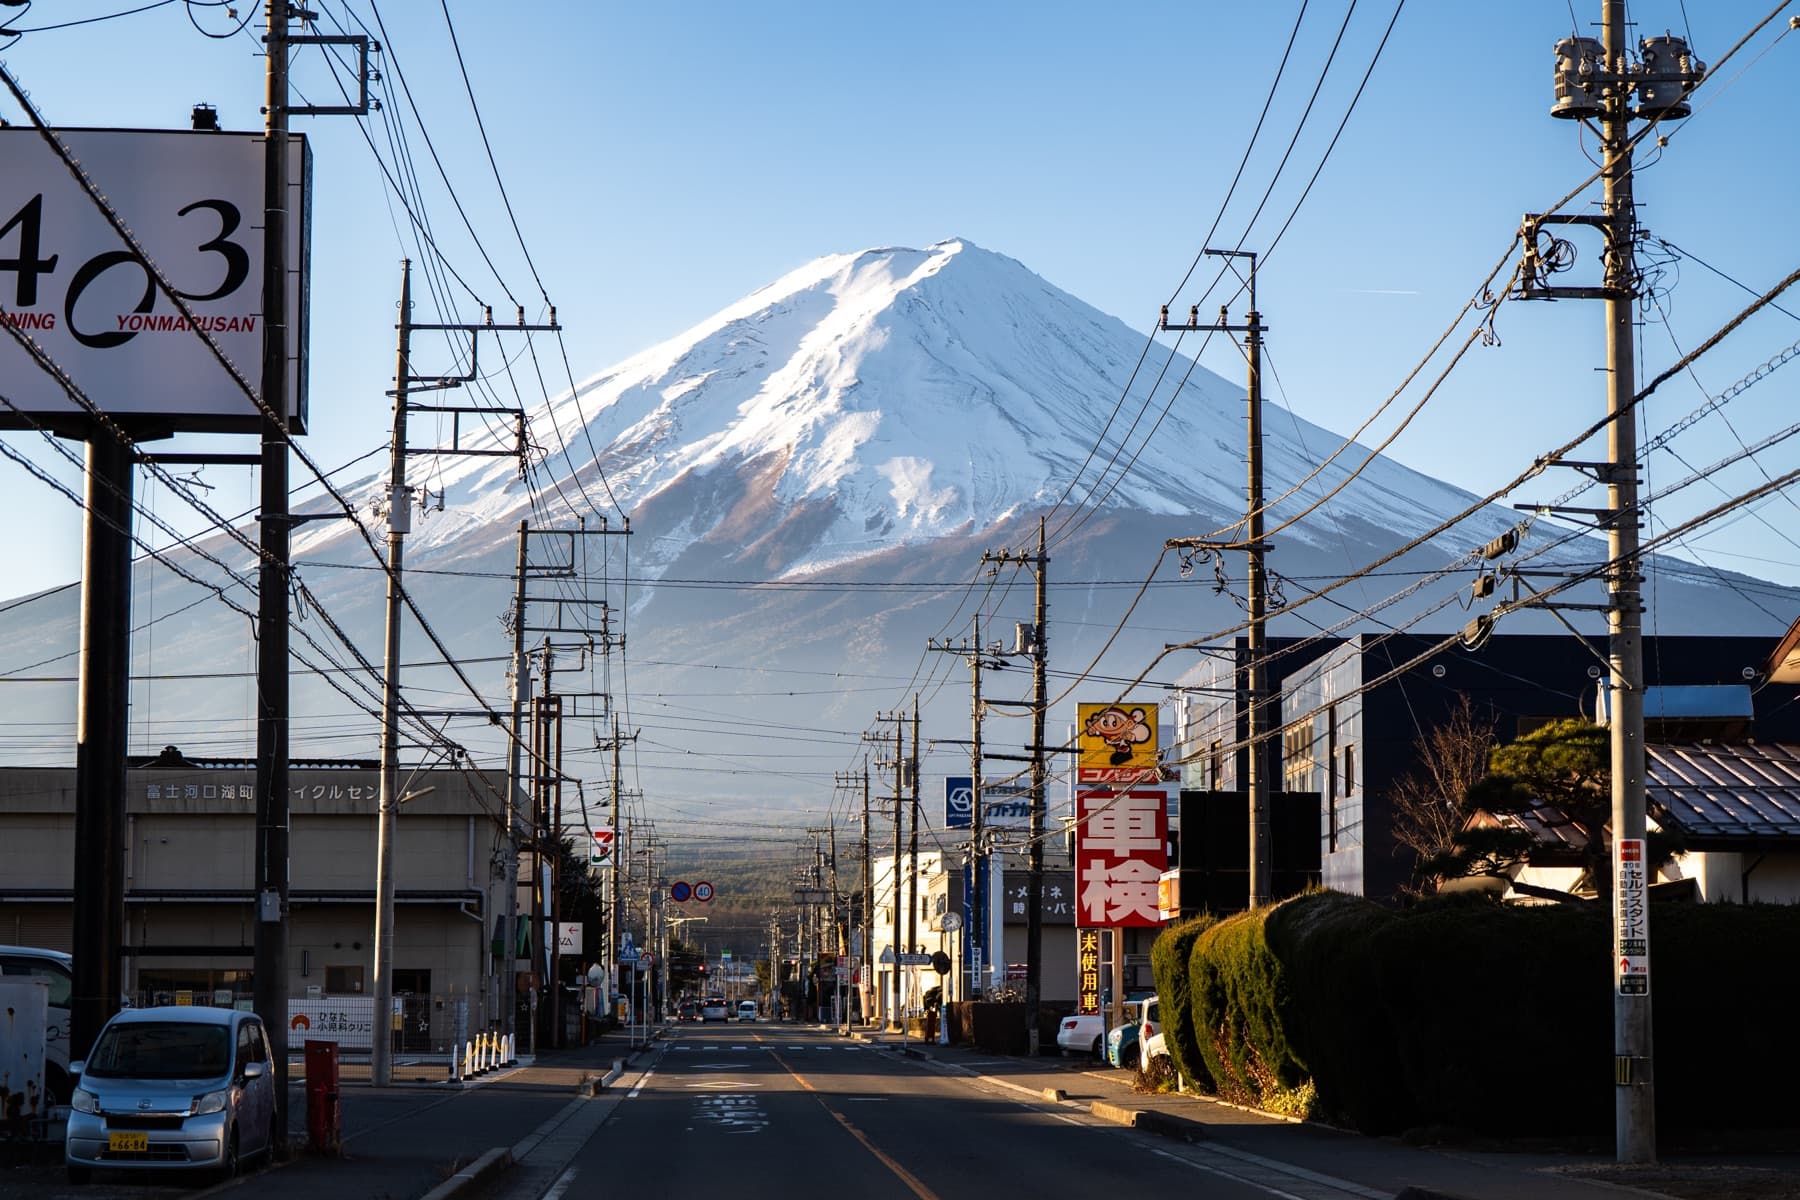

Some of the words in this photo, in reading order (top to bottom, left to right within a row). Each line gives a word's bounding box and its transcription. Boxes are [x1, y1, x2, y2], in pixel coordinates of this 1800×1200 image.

[0, 193, 250, 349] 403
[697, 886, 711, 897] 40
[1081, 794, 1161, 923] 車検
[1628, 869, 1643, 938] セルフスタンド
[1080, 932, 1099, 1012] 未使用車
[319, 1012, 348, 1022] ひなた
